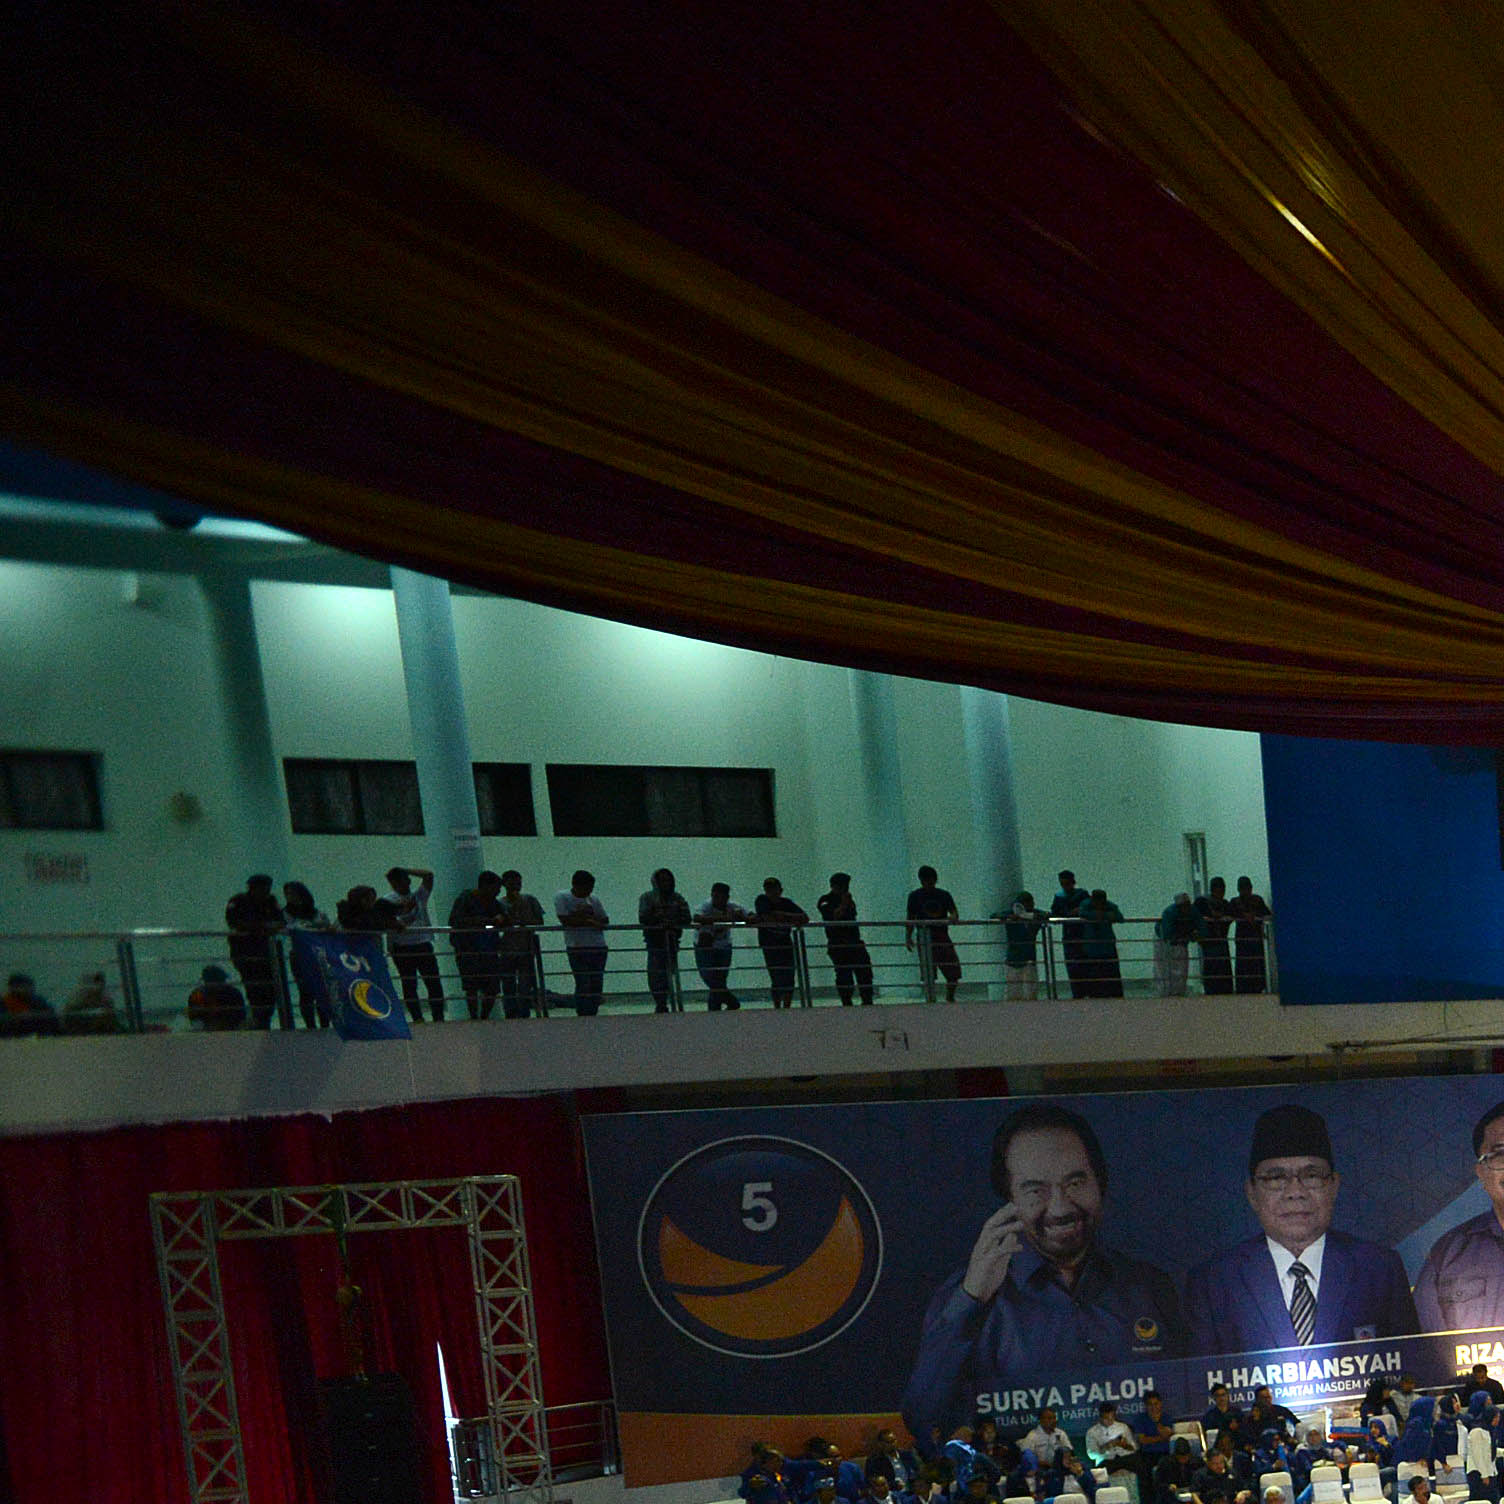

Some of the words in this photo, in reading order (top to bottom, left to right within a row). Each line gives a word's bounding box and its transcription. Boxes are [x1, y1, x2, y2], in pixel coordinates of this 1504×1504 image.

[742, 1182, 778, 1232] 5
[1207, 1352, 1401, 1390] H.HARBIANSYAH
[1275, 1384, 1313, 1398] PARTAI
[1316, 1379, 1361, 1393] NASDEM
[976, 1386, 1064, 1414] SURYA
[1070, 1377, 1155, 1405] PALOH
[1062, 1407, 1100, 1420] PARTA
